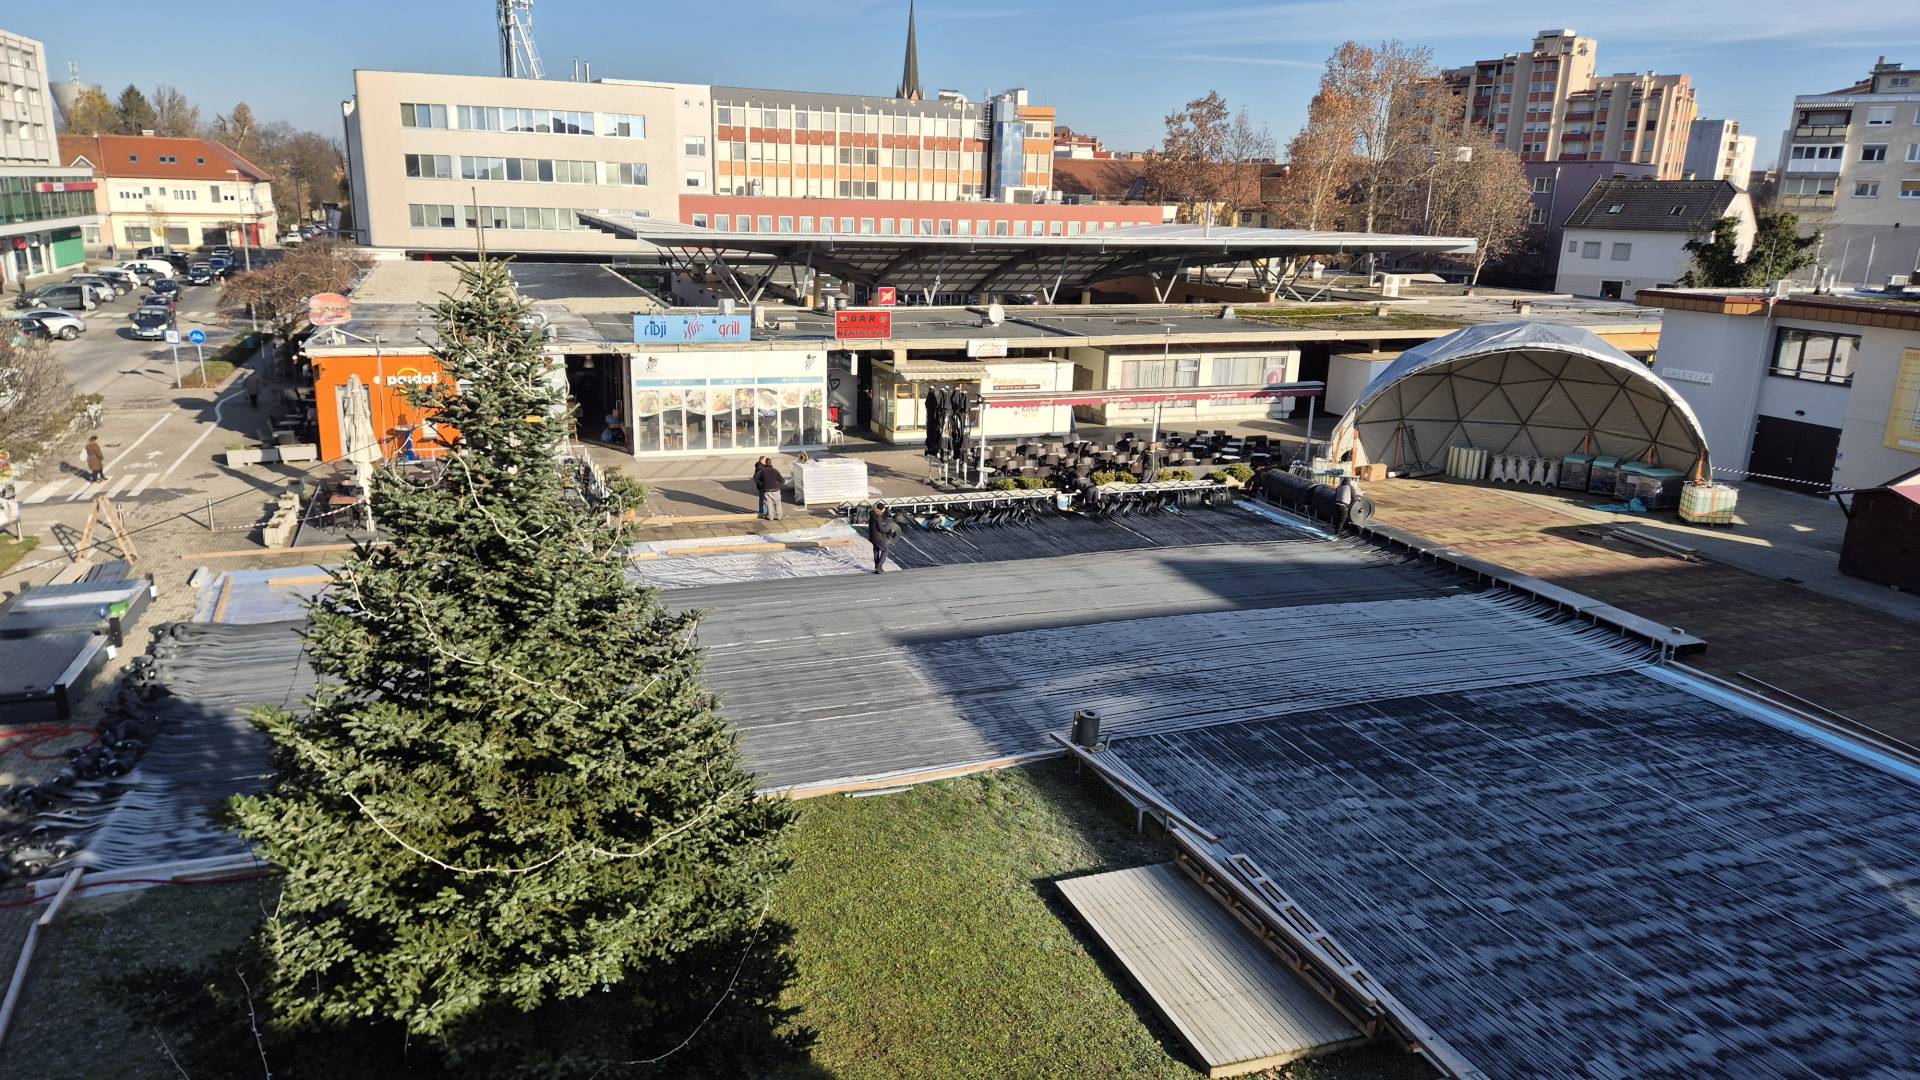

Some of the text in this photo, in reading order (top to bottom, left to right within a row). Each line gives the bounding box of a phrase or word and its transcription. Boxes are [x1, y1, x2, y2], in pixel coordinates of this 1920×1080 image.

[850, 314, 875, 322] BAR
[644, 320, 740, 338] ribji grill
